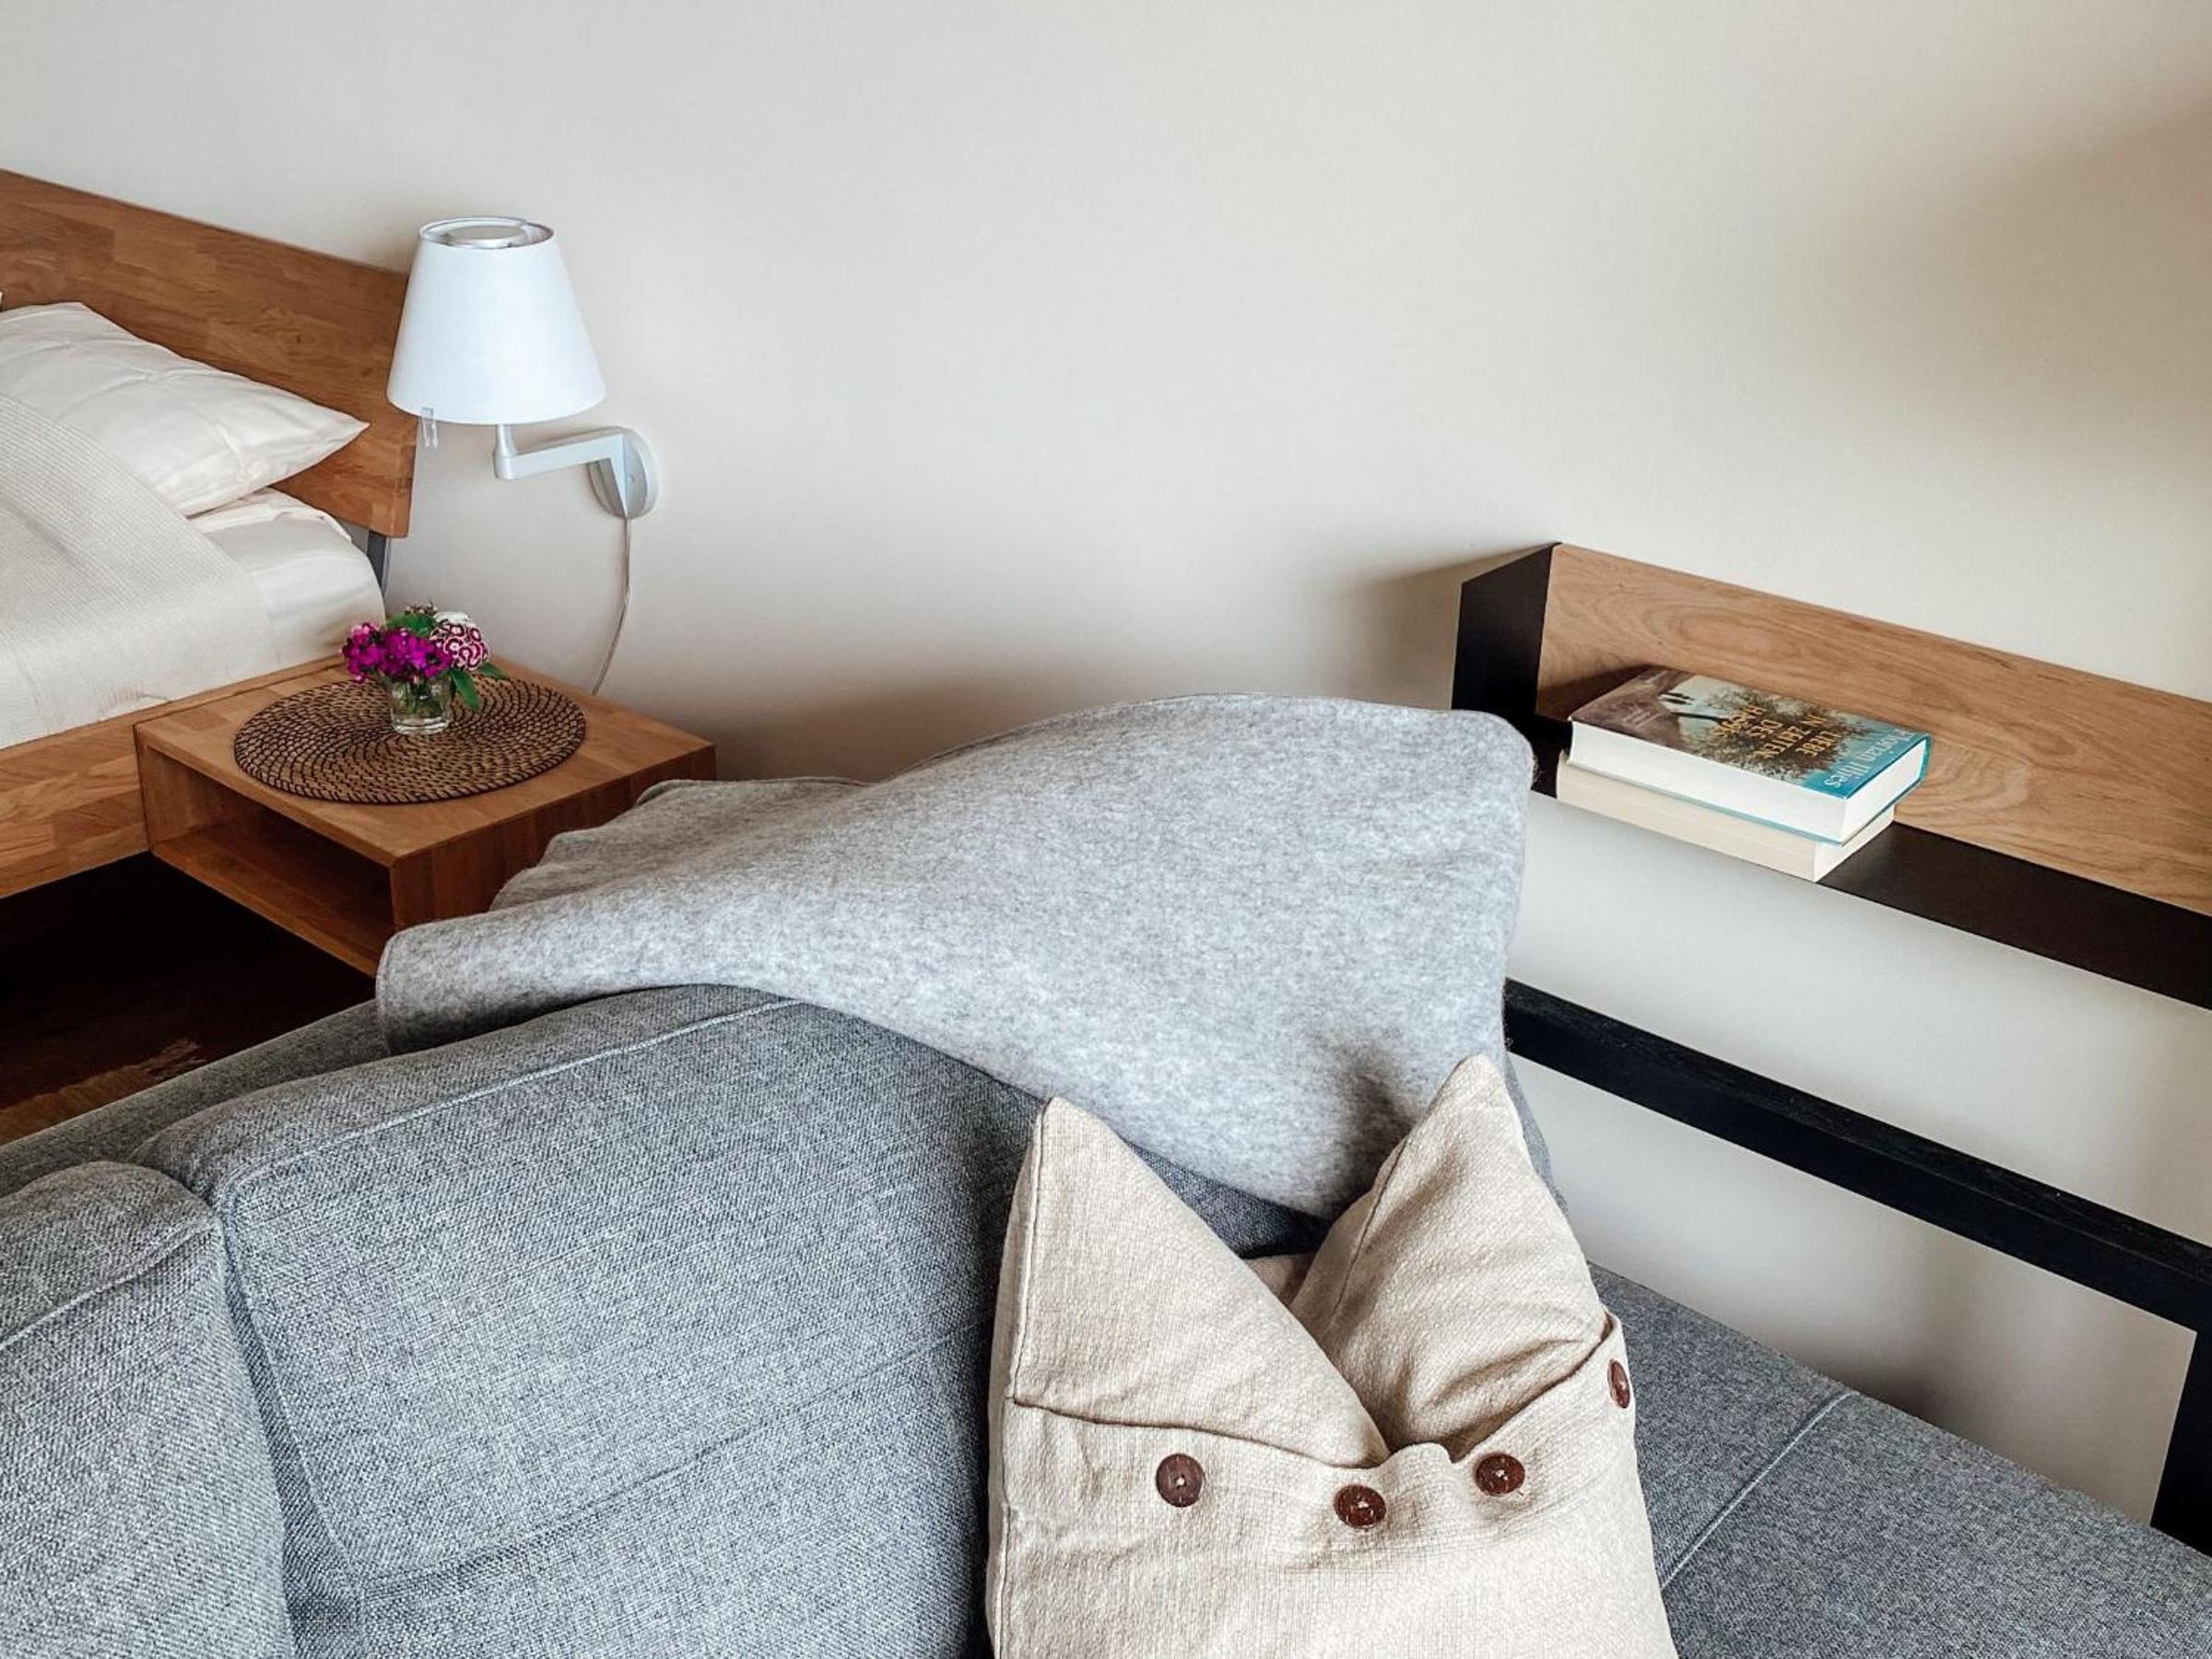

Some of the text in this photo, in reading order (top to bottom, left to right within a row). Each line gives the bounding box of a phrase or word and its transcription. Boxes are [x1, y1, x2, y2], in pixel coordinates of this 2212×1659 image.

[1709, 704, 1767, 737] HASSES
[1746, 719, 1783, 738] DES
[1753, 713, 1830, 759] IN ZEITEN
[1795, 731, 1842, 757] LIEBE
[1824, 728, 1916, 788] Florian Illies
